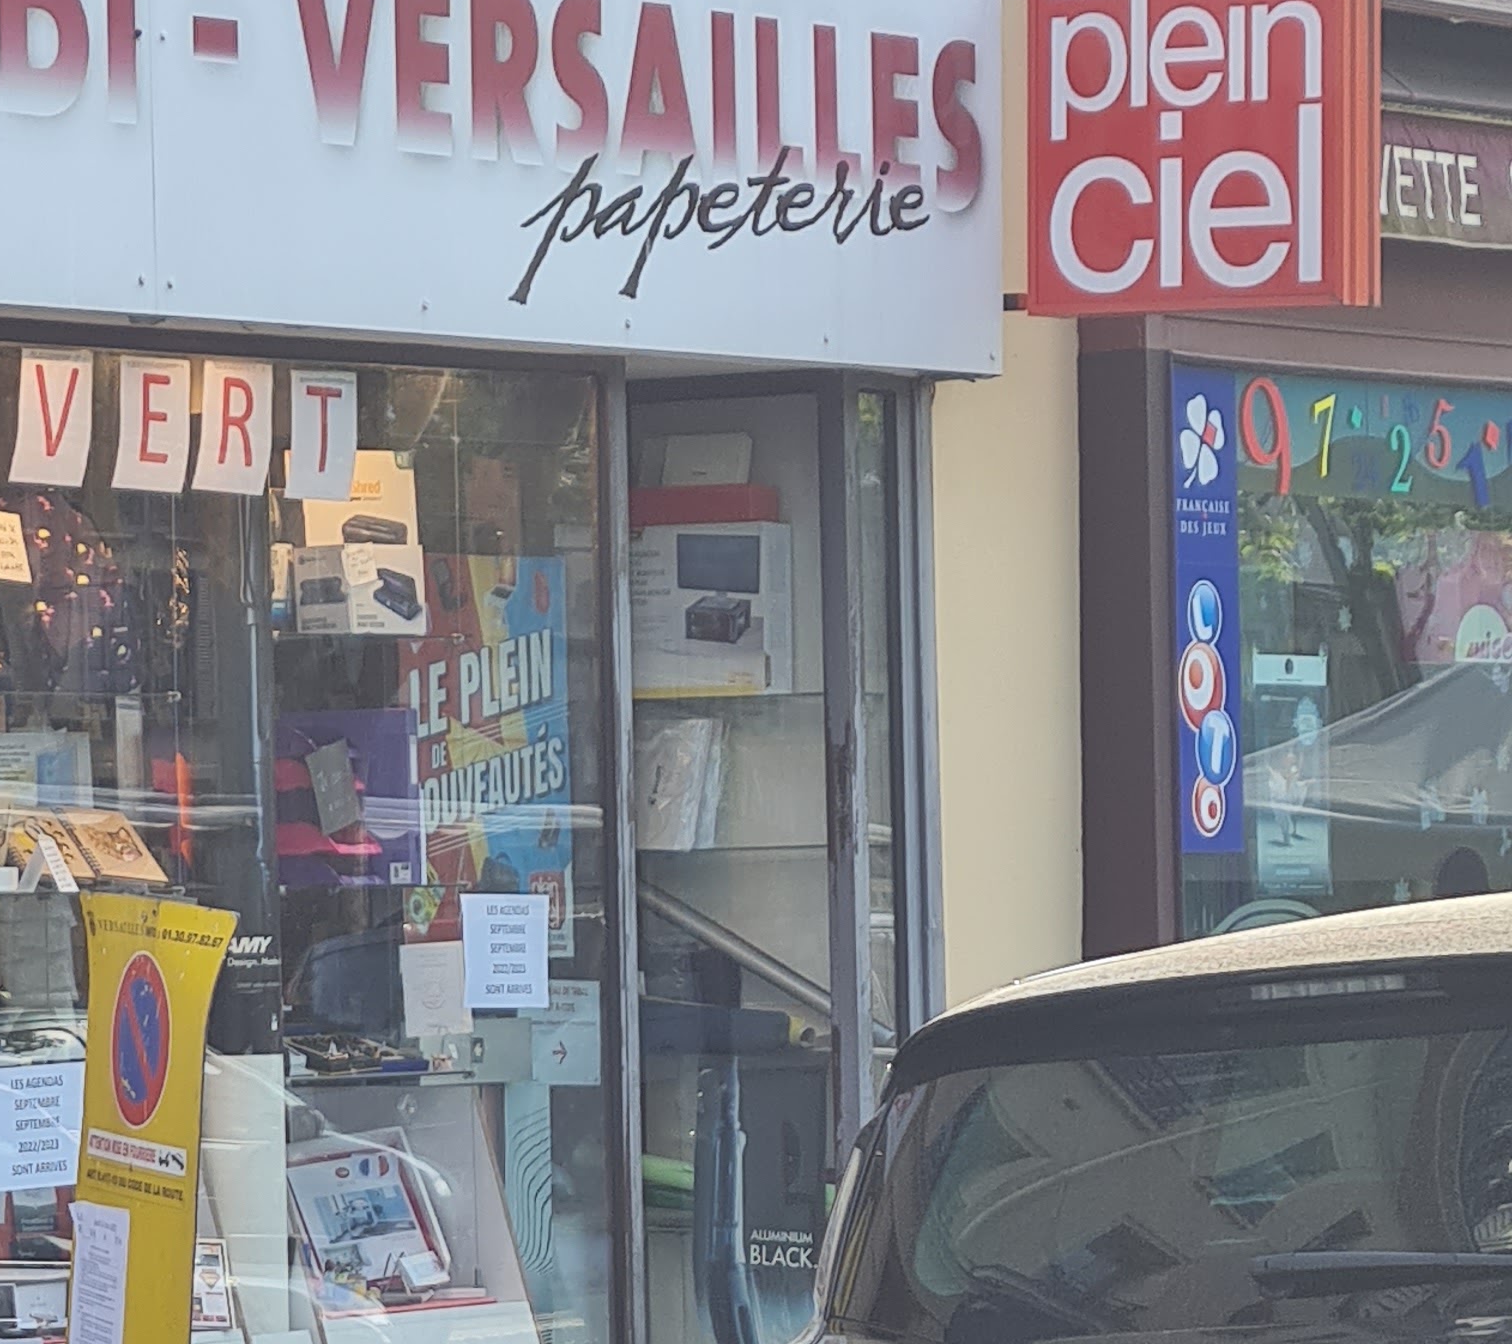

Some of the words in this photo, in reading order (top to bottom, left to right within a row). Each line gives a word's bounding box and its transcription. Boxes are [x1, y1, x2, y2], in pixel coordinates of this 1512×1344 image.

[1048, 103, 1324, 295] ciel
[507, 144, 932, 306] papeterie
[1180, 520, 1199, 535] DES
[1201, 520, 1227, 537] JEUX
[409, 659, 449, 739] LE
[459, 628, 552, 726] PLEIN
[431, 741, 448, 770] DE
[422, 723, 566, 834] OUVEAUTÉS
[228, 935, 273, 954] AMY
[10, 1077, 24, 1090] LES
[18, 1138, 60, 1154] 2022/2023
[11, 1162, 33, 1176] SONT
[749, 1228, 814, 1244] ALUMINIUM
